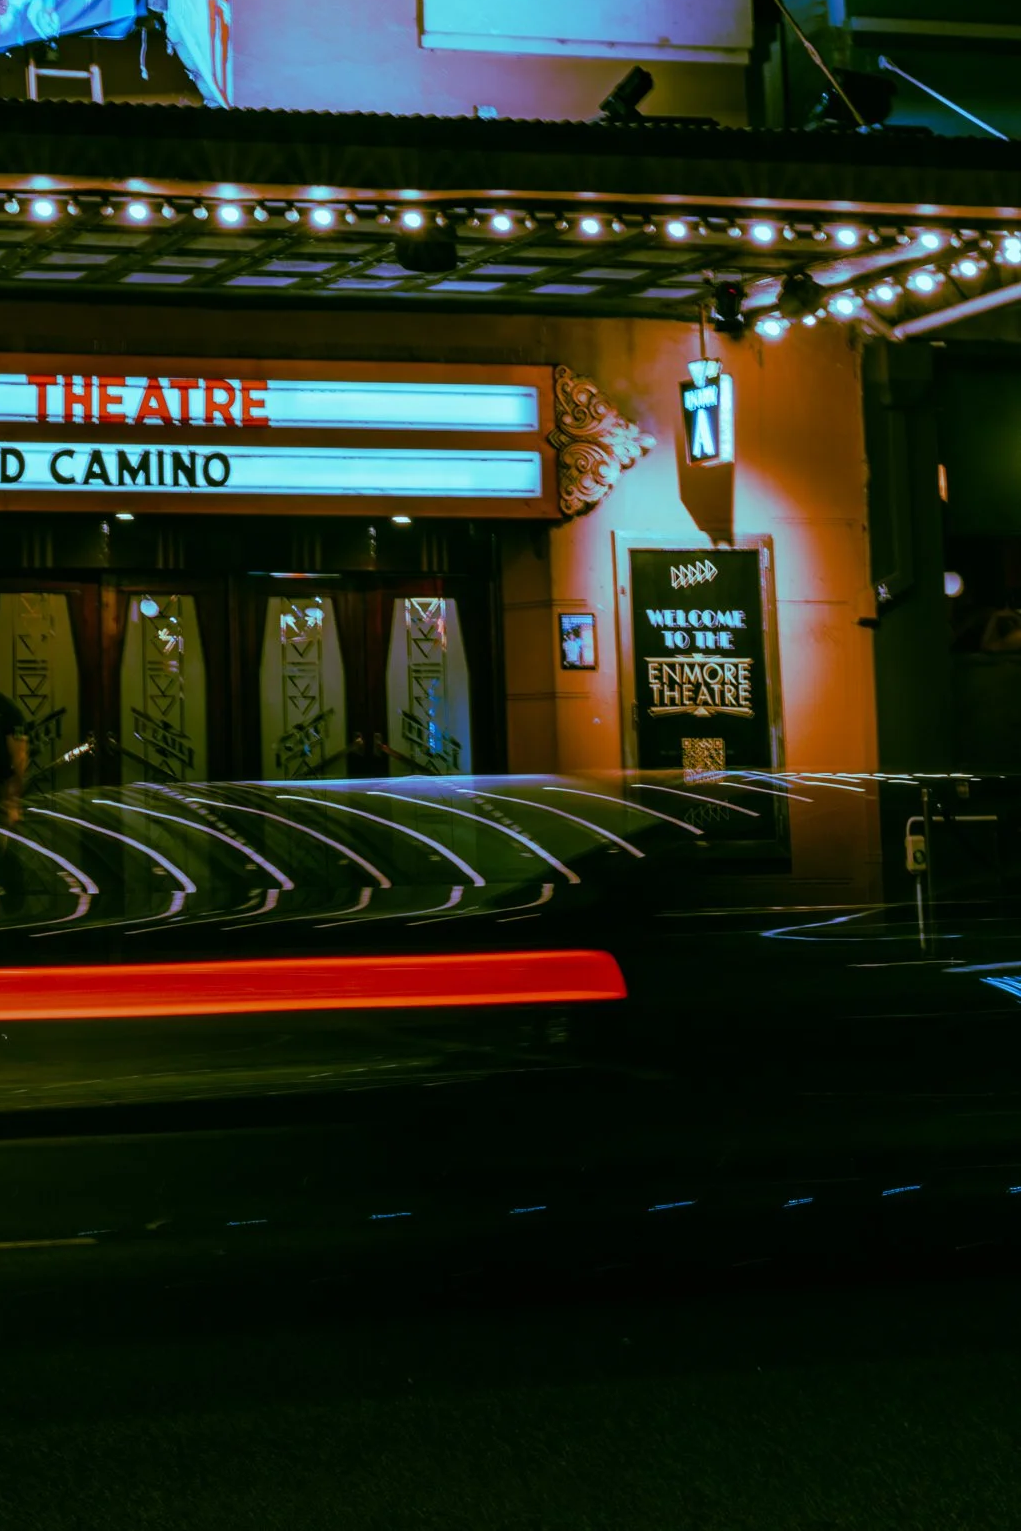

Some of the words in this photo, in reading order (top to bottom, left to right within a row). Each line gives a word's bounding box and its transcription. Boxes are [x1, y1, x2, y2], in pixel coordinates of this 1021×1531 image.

[26, 375, 271, 427] THEATRE
[692, 408, 716, 459] A
[50, 448, 230, 487] CAMINO
[646, 609, 747, 629] WELCOME
[661, 630, 690, 649] TO
[692, 630, 736, 650] THE
[648, 663, 751, 685] ENMORE
[649, 684, 752, 706] THEATRE
